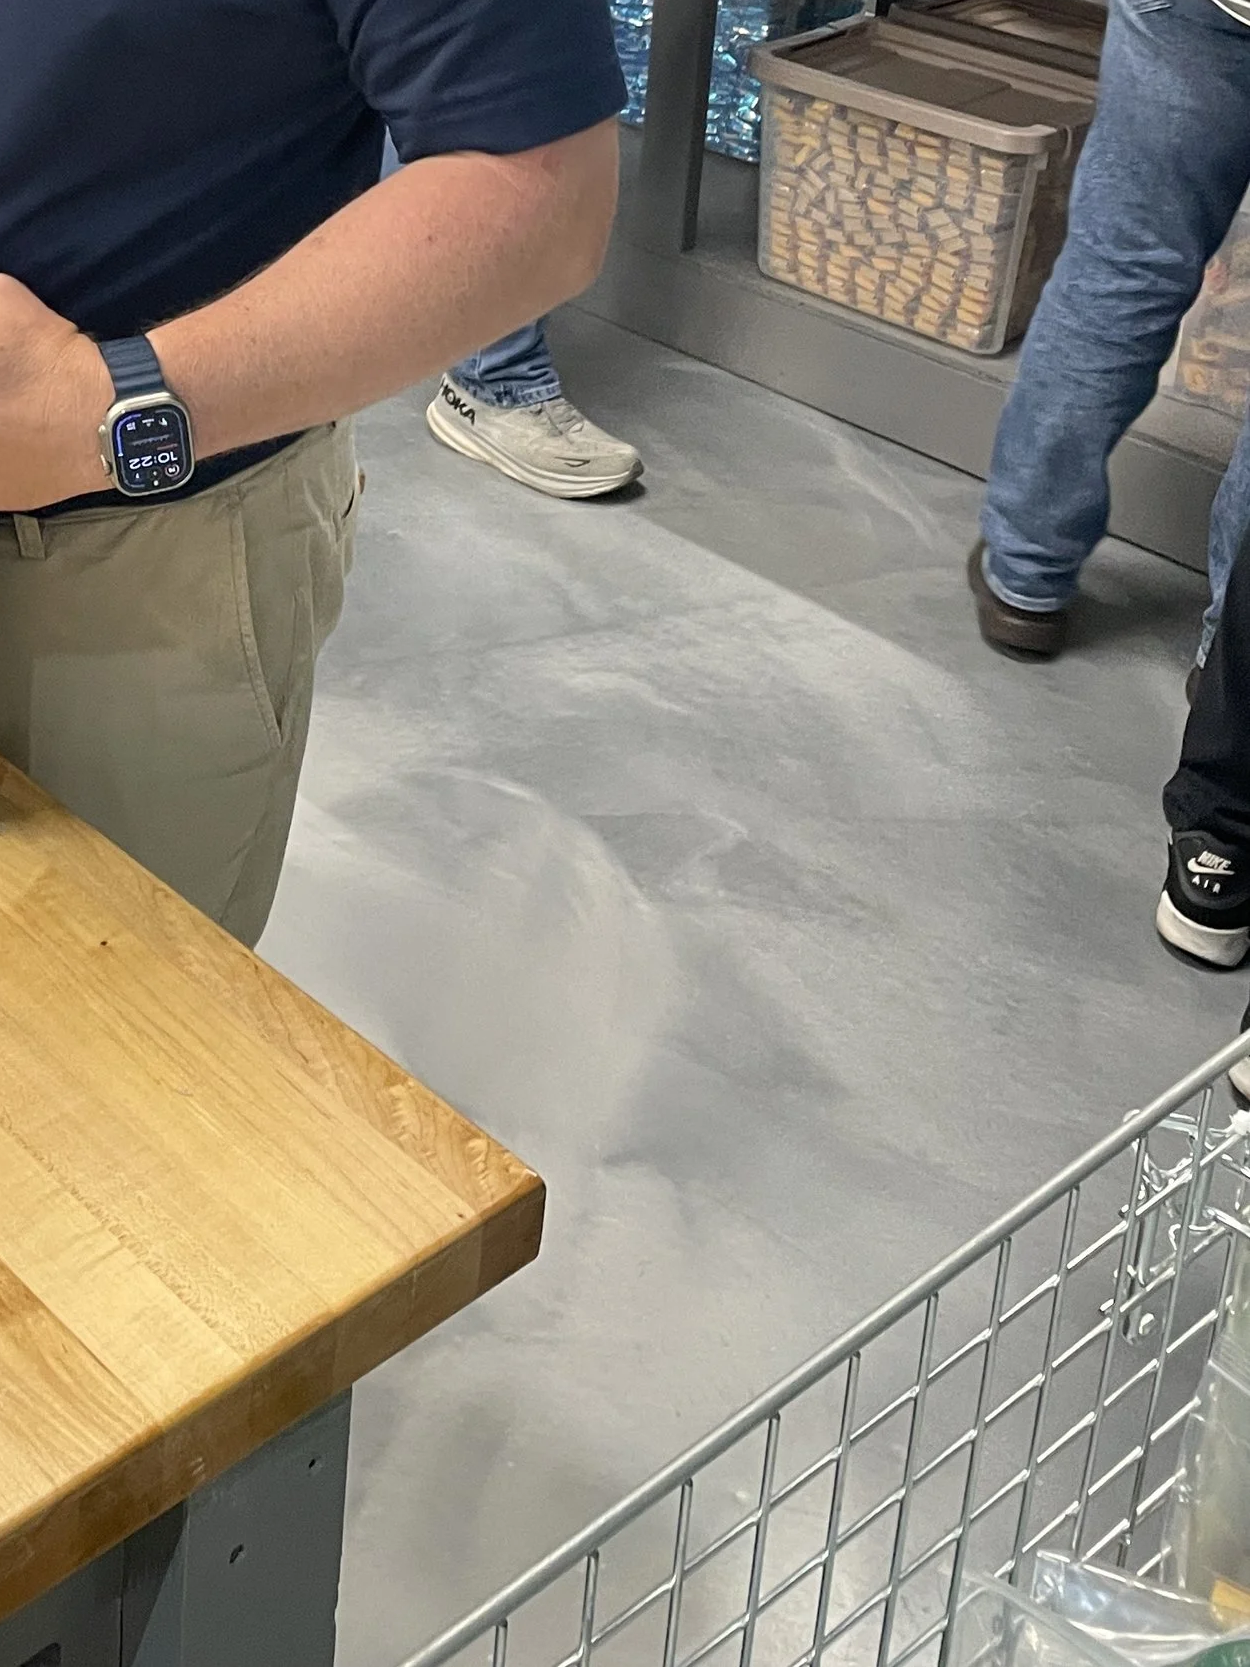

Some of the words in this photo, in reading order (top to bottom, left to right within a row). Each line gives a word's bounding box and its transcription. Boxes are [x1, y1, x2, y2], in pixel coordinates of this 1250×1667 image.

[440, 381, 477, 426] HOKA
[128, 451, 179, 470] 10:22
[1196, 850, 1232, 870] NIKE
[1191, 874, 1221, 894] AIR
